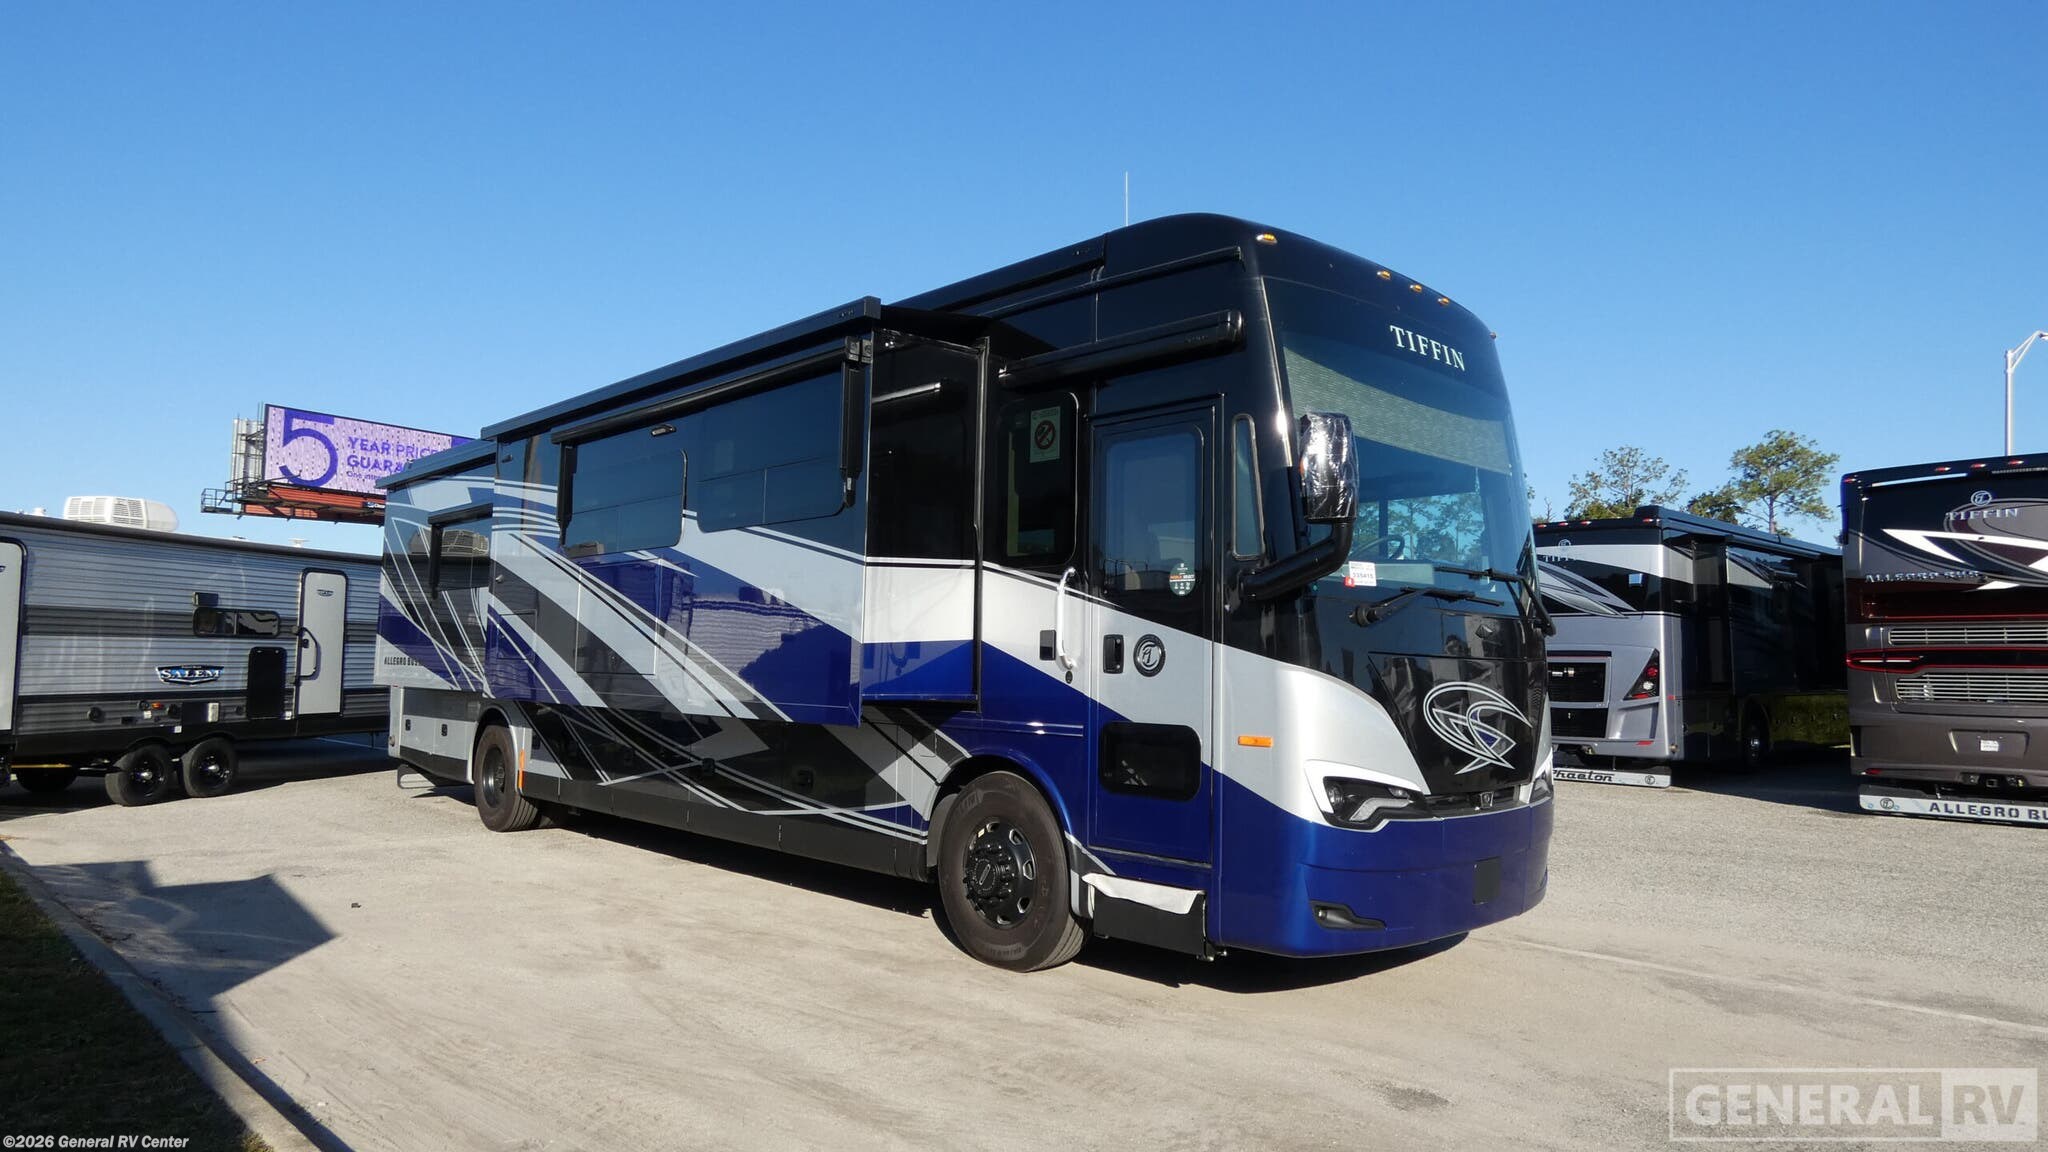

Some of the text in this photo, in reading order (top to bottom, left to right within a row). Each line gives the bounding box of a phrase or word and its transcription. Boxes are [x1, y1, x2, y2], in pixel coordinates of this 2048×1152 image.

[1389, 325, 1465, 371] TIFFIN
[279, 408, 338, 488] 5
[347, 436, 392, 456] YEAR
[346, 454, 405, 473] GUARA
[1946, 508, 2018, 521] TIFFIN
[1866, 571, 1939, 583] ALLEGRO
[384, 656, 406, 666] ALLEGRO
[160, 669, 220, 679] SALEM
[1929, 802, 2020, 819] ALLEGRO
